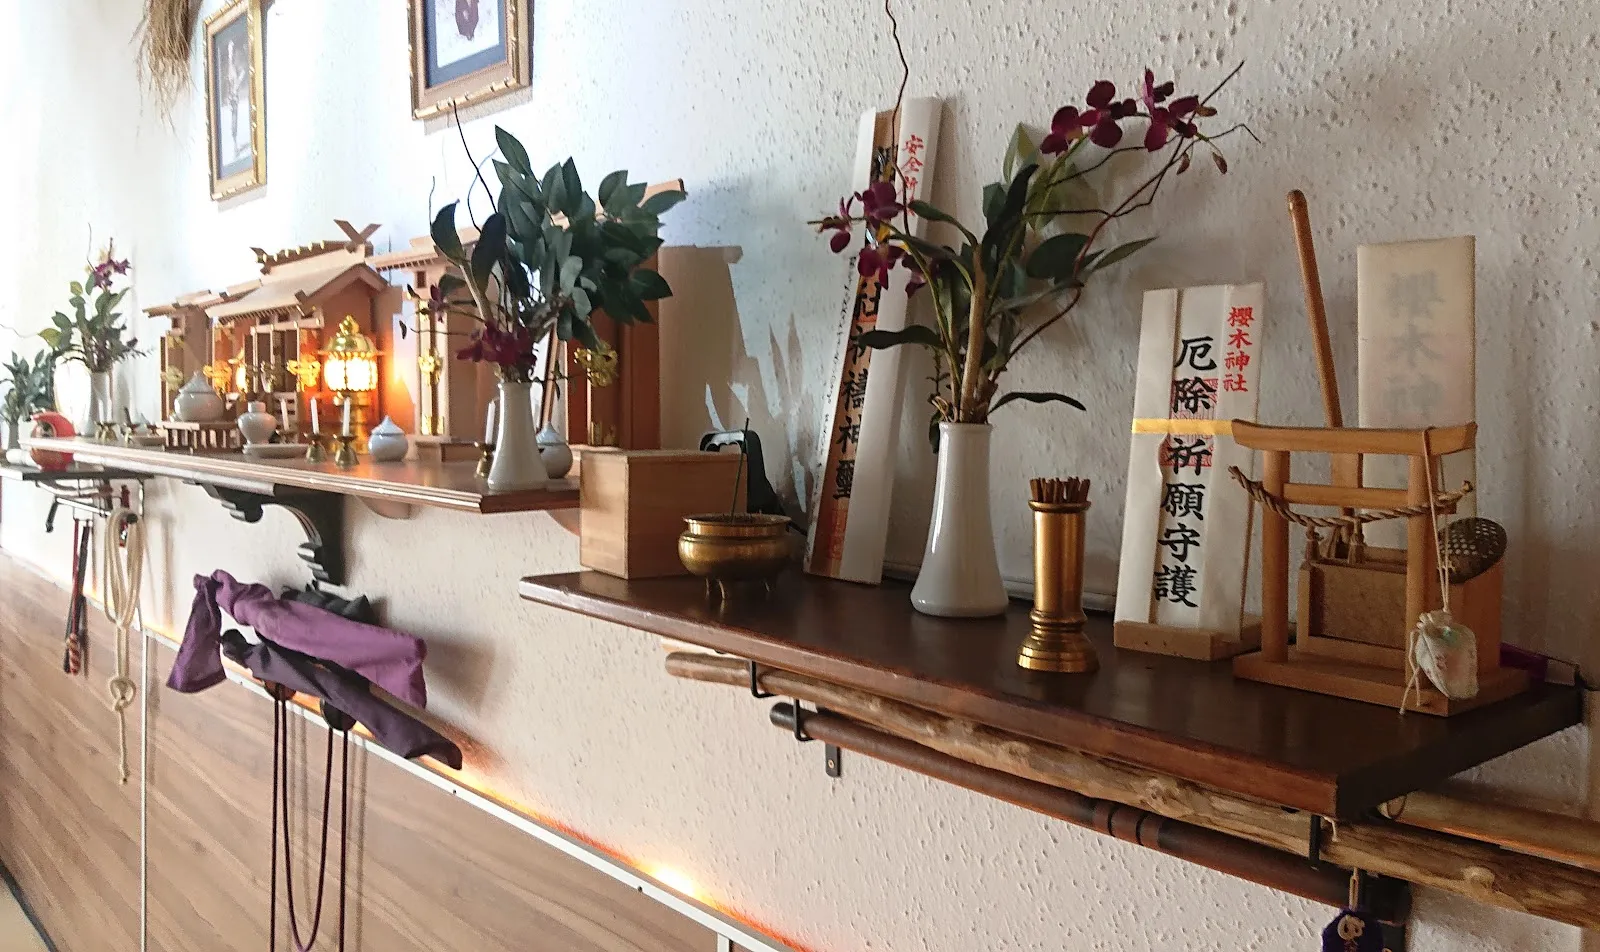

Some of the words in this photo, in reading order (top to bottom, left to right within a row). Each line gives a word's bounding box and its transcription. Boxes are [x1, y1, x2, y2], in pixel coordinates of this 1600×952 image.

[897, 134, 924, 216] 安全祈
[1222, 305, 1255, 393] 櫻木神社
[1153, 335, 1218, 608] 厄除祈願守護
